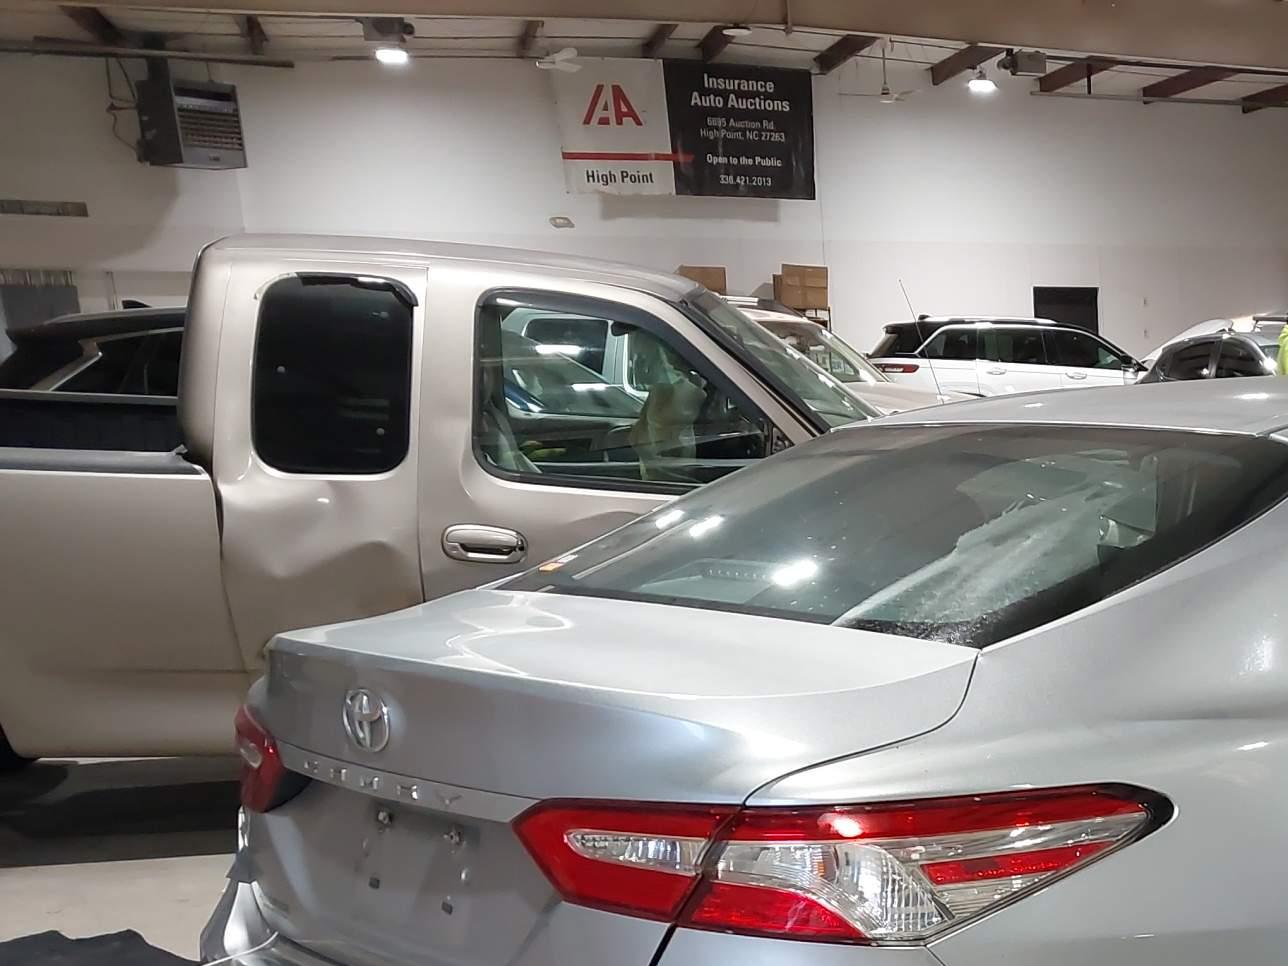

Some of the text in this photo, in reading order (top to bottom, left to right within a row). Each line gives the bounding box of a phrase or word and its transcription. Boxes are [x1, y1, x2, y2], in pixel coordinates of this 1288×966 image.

[704, 73, 775, 93] Insurance
[691, 91, 791, 112] Auto Auctions
[729, 118, 761, 129] Auction
[700, 128, 719, 140] High
[747, 130, 760, 141] NC
[761, 131, 786, 142] 27263
[706, 153, 783, 168] Open to the Public
[586, 169, 655, 187] High Point
